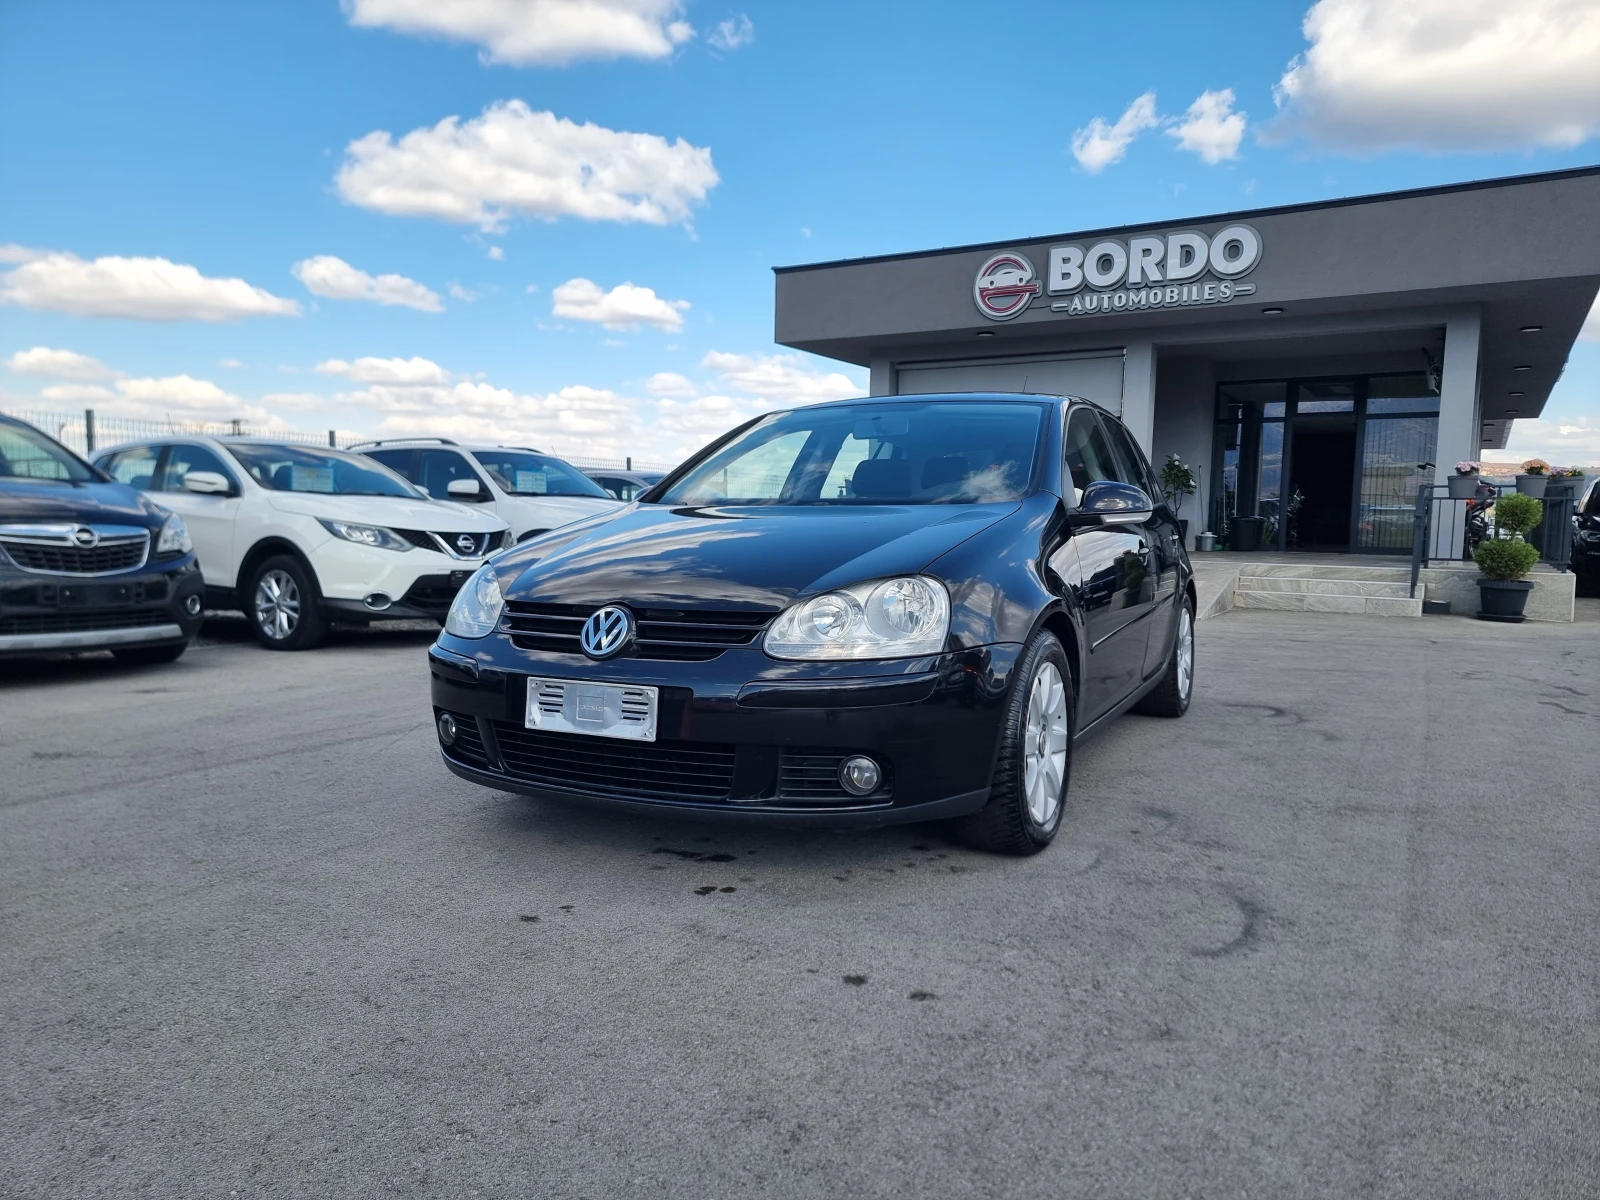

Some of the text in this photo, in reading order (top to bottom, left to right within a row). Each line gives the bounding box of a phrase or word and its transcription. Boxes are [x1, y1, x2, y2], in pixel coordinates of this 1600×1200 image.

[1049, 226, 1259, 291] BORDO
[1070, 282, 1231, 312] AUTOMOBILES
[582, 607, 628, 655] VW
